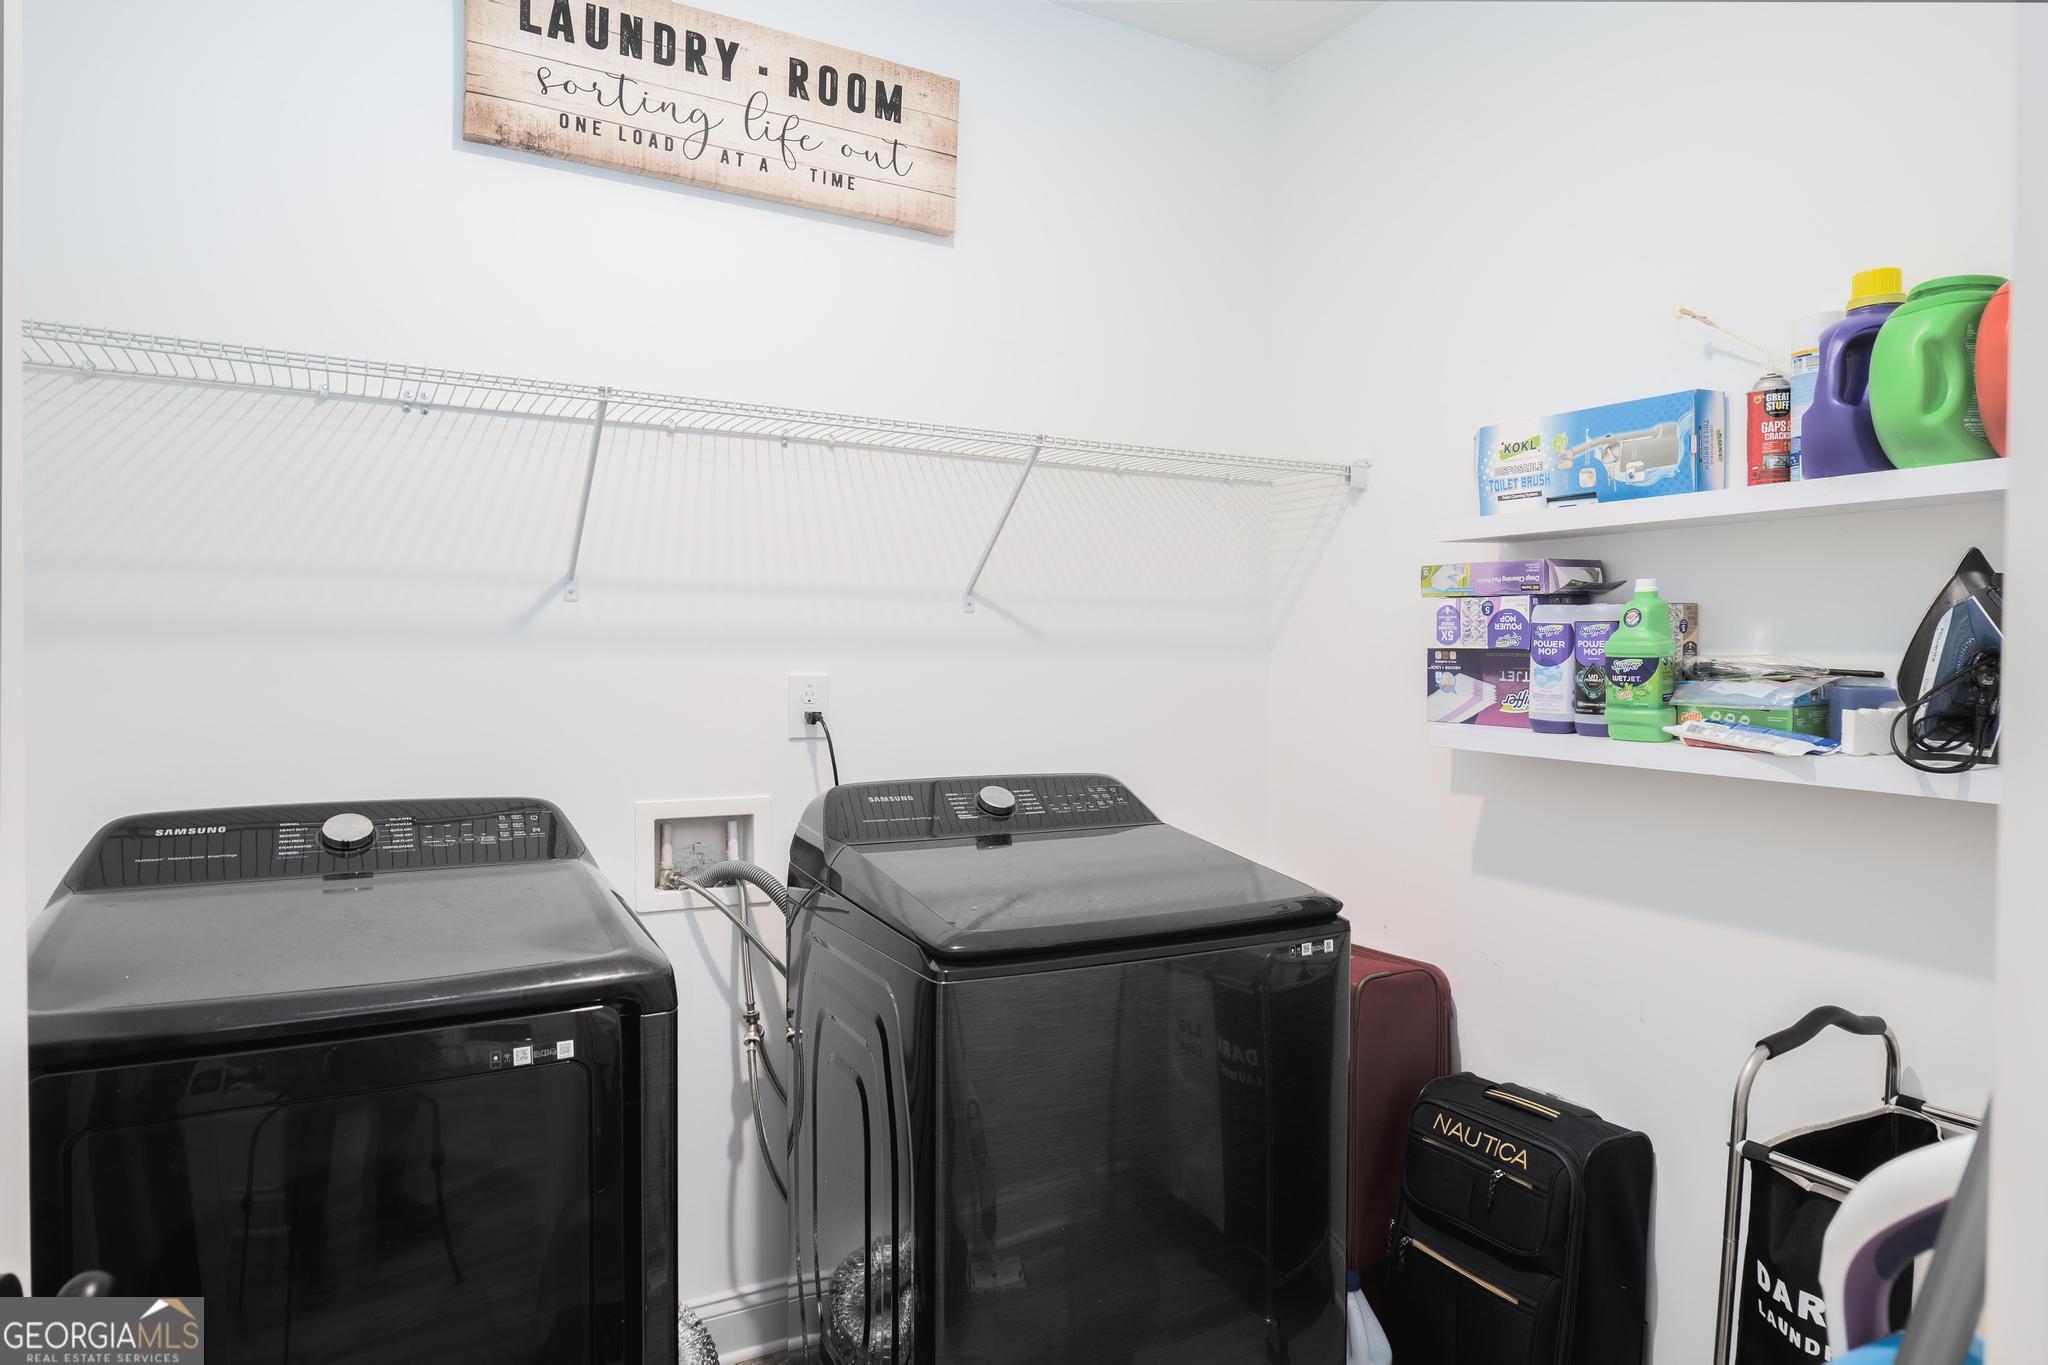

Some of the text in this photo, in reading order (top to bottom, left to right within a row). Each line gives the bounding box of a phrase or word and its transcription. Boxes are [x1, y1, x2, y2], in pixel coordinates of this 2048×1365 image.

[519, 0, 740, 81] LAUNDRY
[788, 57, 904, 123] ROOM
[537, 66, 914, 176] sorting life out
[559, 112, 857, 191] ONE LOAD AT A TIME
[1765, 392, 1790, 402] GREAT
[1765, 401, 1790, 412] STUFF
[1761, 420, 1786, 433] GAPS
[1764, 432, 1791, 441] CRACKS
[1503, 440, 1537, 453] KOKL
[1494, 461, 1543, 477] DISPOSABLE
[1488, 472, 1550, 493] TOILET BRUSH
[1502, 575, 1525, 583] Cleaning
[1441, 630, 1454, 640] 5X
[1535, 625, 1563, 637] Swiffer
[1580, 625, 1609, 637] Swiffer
[1533, 640, 1565, 648] POWER
[1577, 640, 1605, 648] POWE
[1611, 660, 1643, 673] Swiffer
[1499, 670, 1530, 682] TJET
[1502, 690, 1529, 709] iffer
[1680, 711, 1702, 723] Gain
[155, 826, 227, 836] SAMSUNG
[1433, 1113, 1527, 1170] NAUTICA
[1757, 1259, 1827, 1328] DAR
[1758, 1299, 1832, 1361] LAUND
